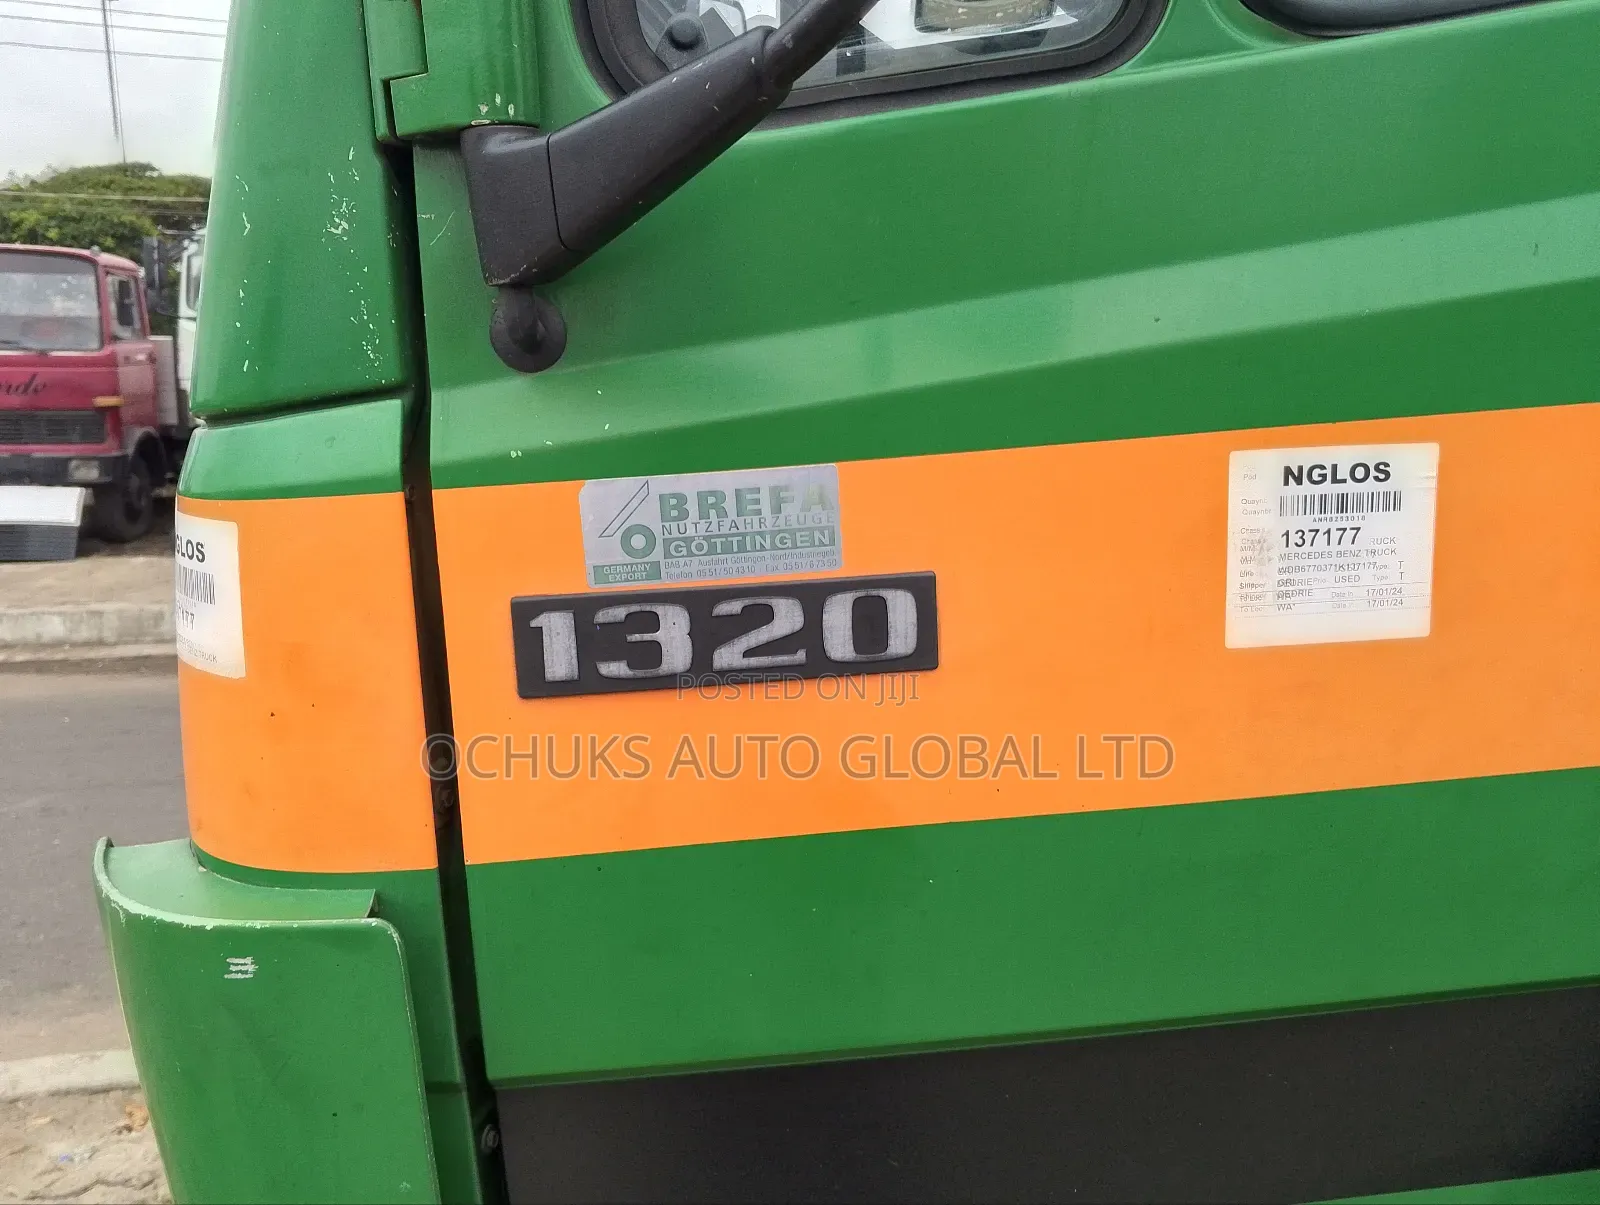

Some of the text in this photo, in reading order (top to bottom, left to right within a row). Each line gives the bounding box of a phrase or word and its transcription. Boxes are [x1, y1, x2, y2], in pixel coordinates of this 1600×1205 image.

[1283, 461, 1391, 487] NGLOS
[658, 483, 834, 523] BREFA
[661, 511, 835, 536] NUTZFAHRZEUGE
[669, 529, 831, 557] GÖTTINGEN
[1280, 526, 1362, 549] 137177
[1279, 548, 1397, 562] MERCEDES BENZ TRUCK
[603, 563, 651, 575] GERMANY
[608, 571, 647, 583] EXPORT
[1334, 574, 1361, 584] USED
[1365, 587, 1403, 597] 17/01/24
[1366, 598, 1404, 608] 17/01/24
[529, 587, 919, 682] 1320
